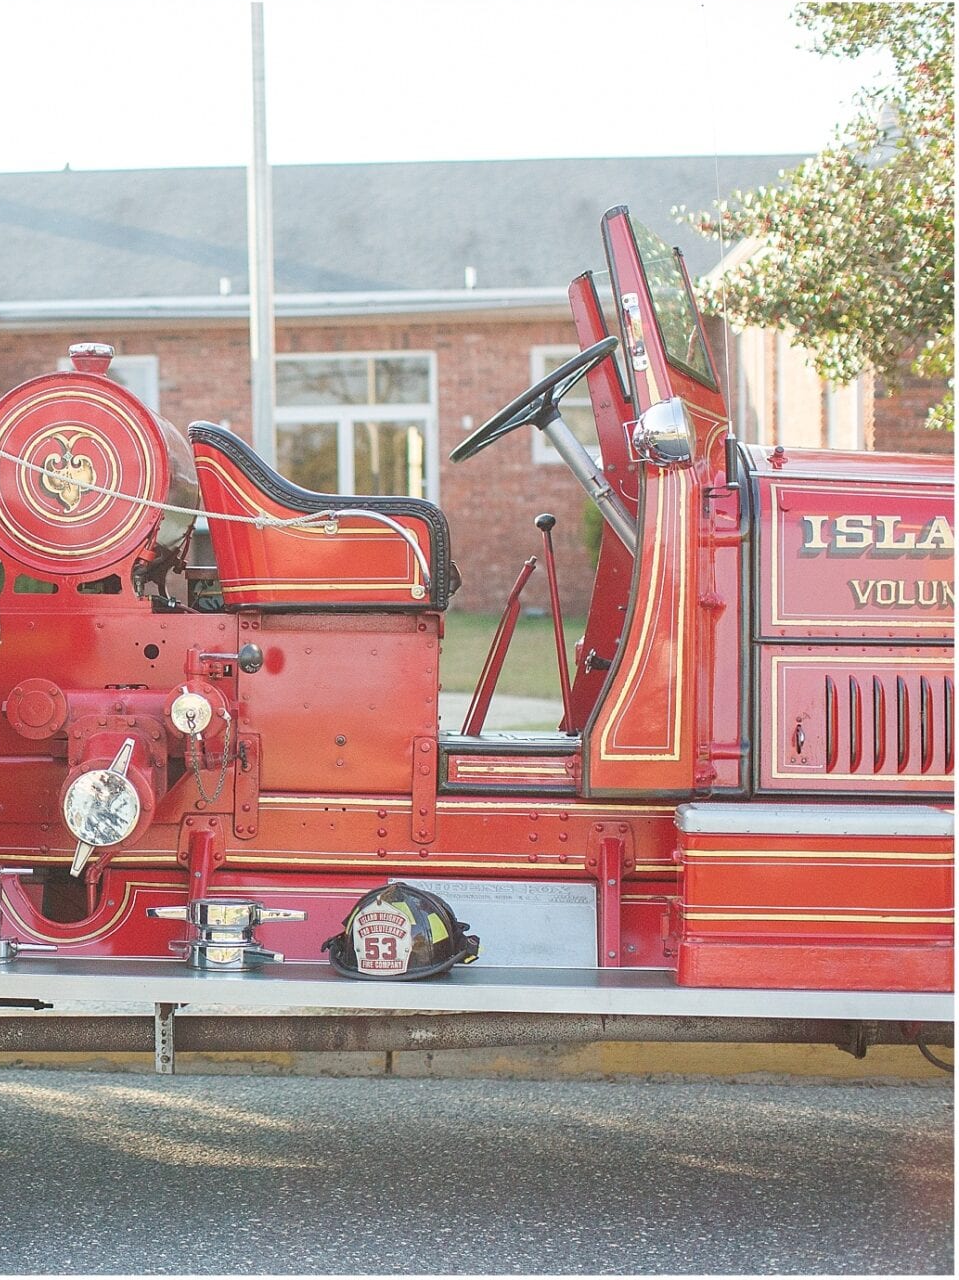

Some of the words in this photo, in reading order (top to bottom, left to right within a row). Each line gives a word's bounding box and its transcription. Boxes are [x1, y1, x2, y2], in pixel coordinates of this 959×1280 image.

[803, 515, 954, 549] ISLA
[359, 912, 378, 925] ISLAND
[379, 912, 405, 926] HEIGHTS
[371, 925, 405, 938] LIEUTENANT
[365, 937, 397, 960] 53
[362, 960, 375, 969] FIRE
[375, 960, 402, 969] COMPANY
